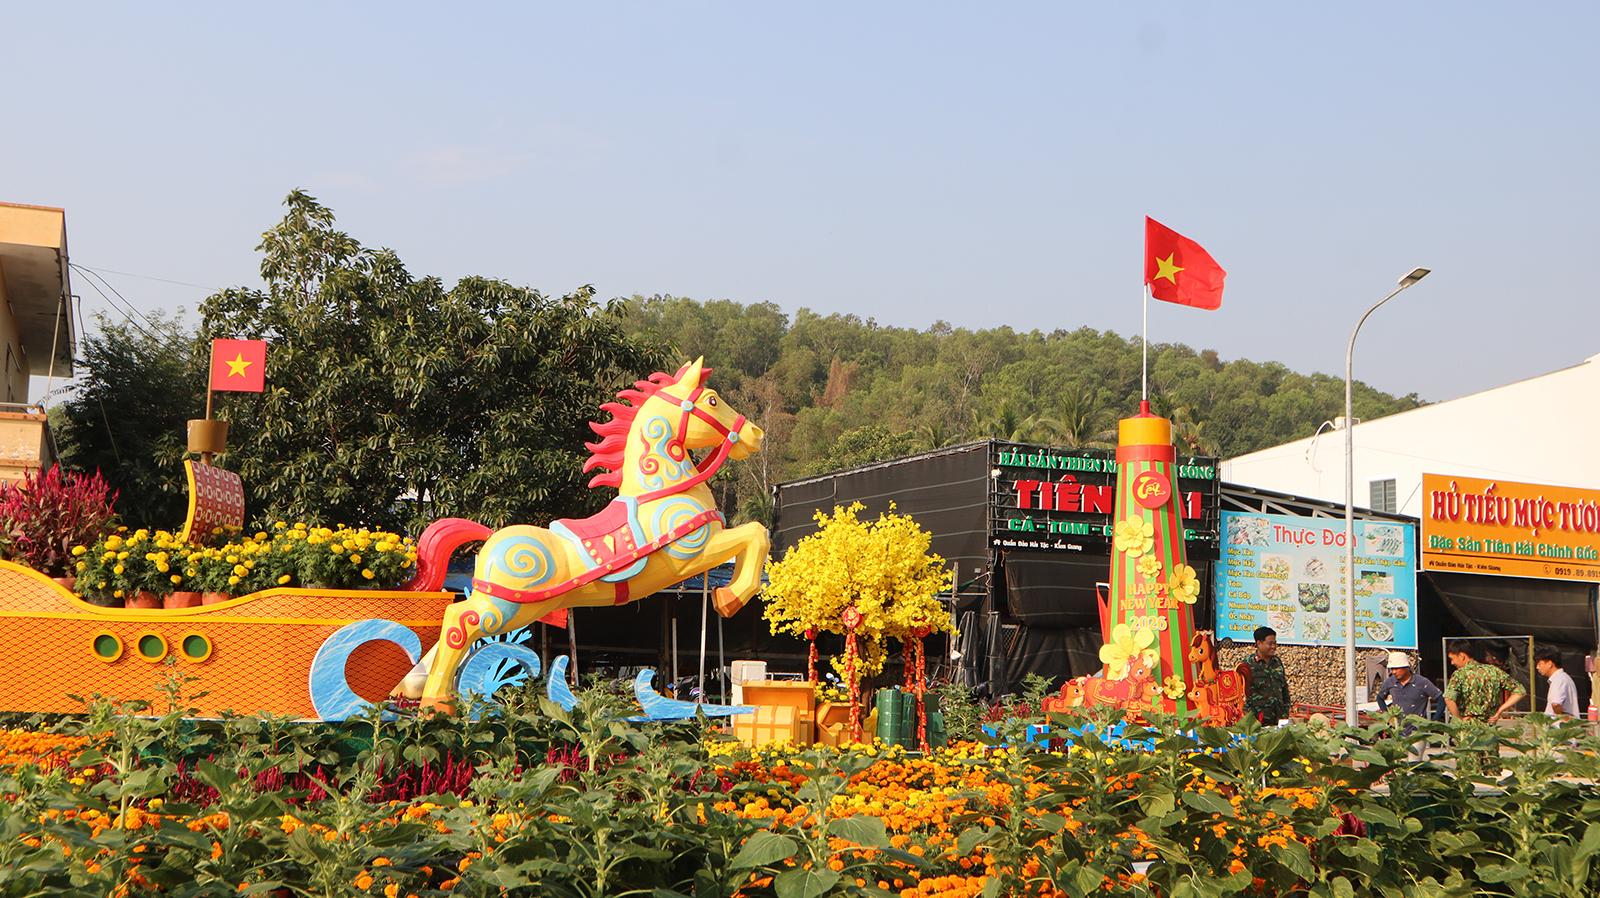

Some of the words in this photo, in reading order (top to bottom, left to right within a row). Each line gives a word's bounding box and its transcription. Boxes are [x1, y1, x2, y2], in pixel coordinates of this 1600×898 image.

[999, 447, 1027, 467] HẢI
[1028, 449, 1057, 469] SẢN
[1059, 453, 1100, 472] THIÊN
[1179, 457, 1215, 480] SỐNG
[1013, 474, 1112, 515] TIÊN
[1431, 480, 1461, 521] HỦ
[1462, 482, 1510, 526] TIẾU
[1512, 496, 1554, 537] MỰC
[1008, 516, 1034, 532] CÁ
[1273, 525, 1316, 548] Thực
[1429, 535, 1453, 553] Đặc
[1484, 538, 1512, 554] Tiên
[1537, 543, 1573, 558] Chính
[1128, 583, 1171, 595] HAPPY
[1120, 599, 1147, 610] NEW
[1147, 597, 1179, 609] YEAR
[1129, 616, 1168, 631] 2026
